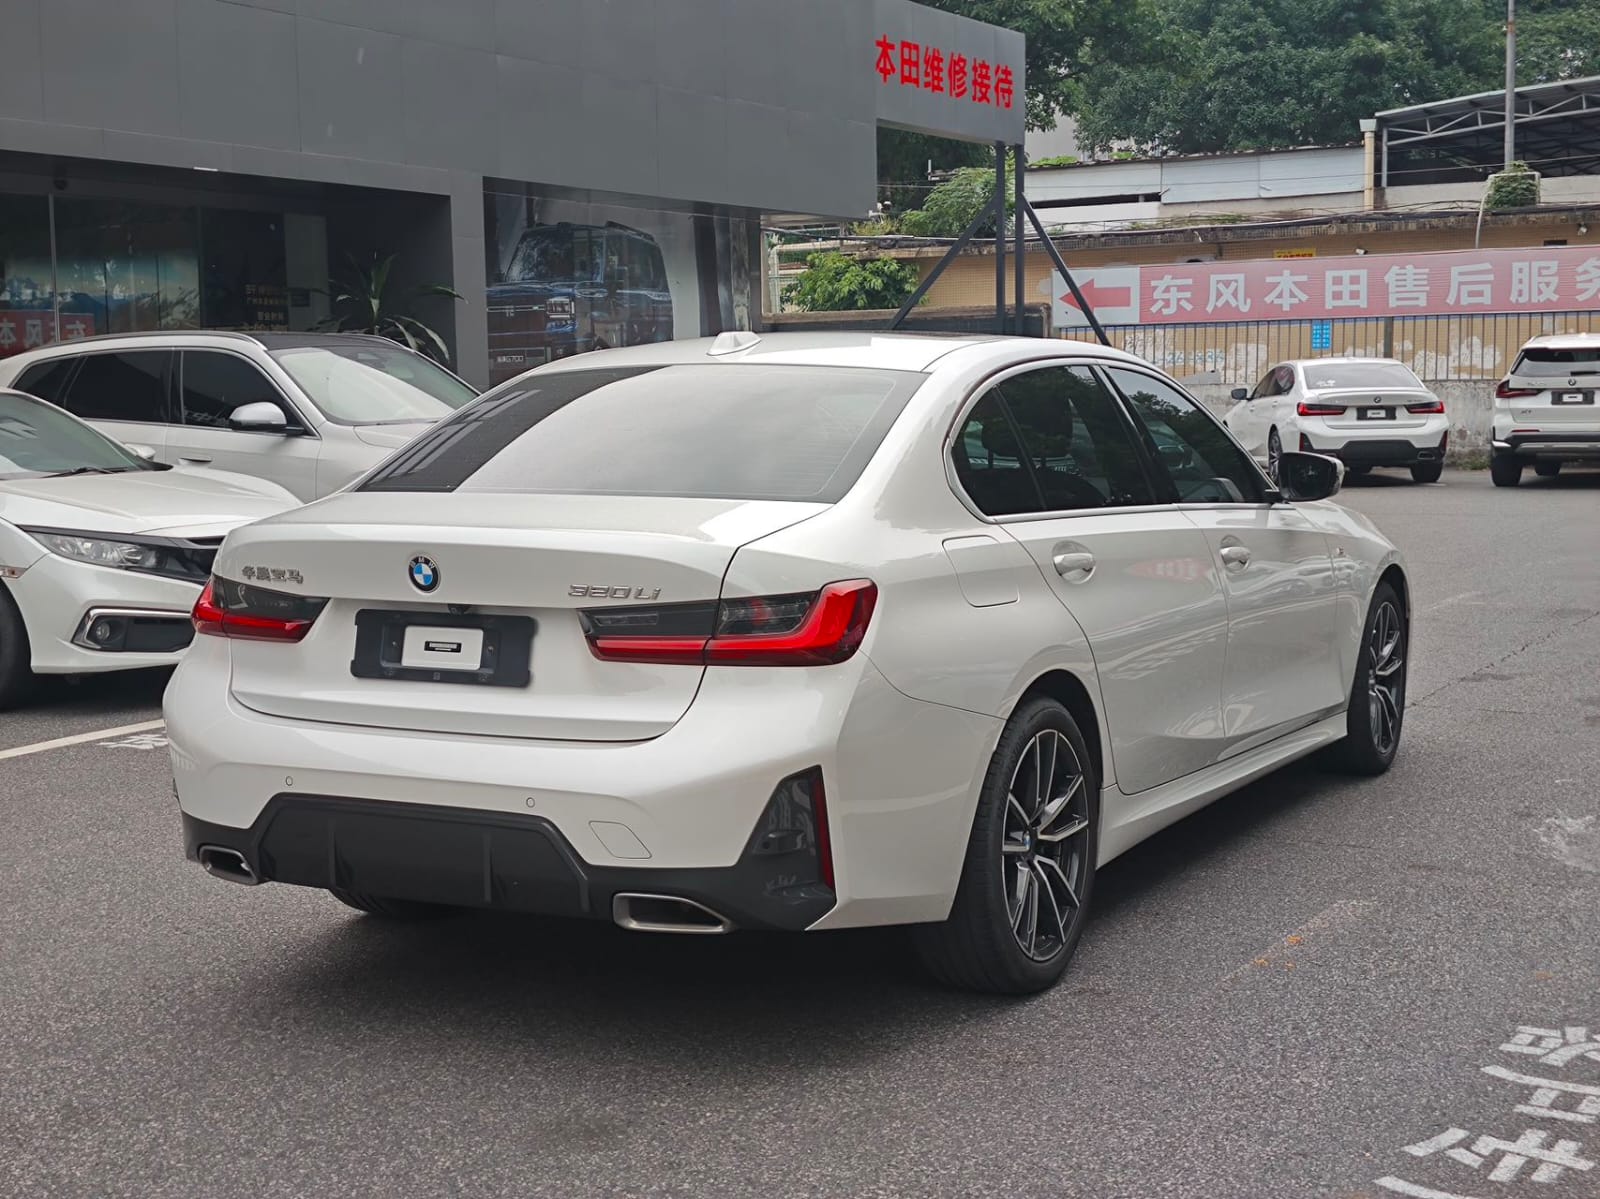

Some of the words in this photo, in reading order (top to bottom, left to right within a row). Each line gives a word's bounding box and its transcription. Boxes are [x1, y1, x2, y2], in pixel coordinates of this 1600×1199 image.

[875, 33, 1014, 109] 本田维修接待
